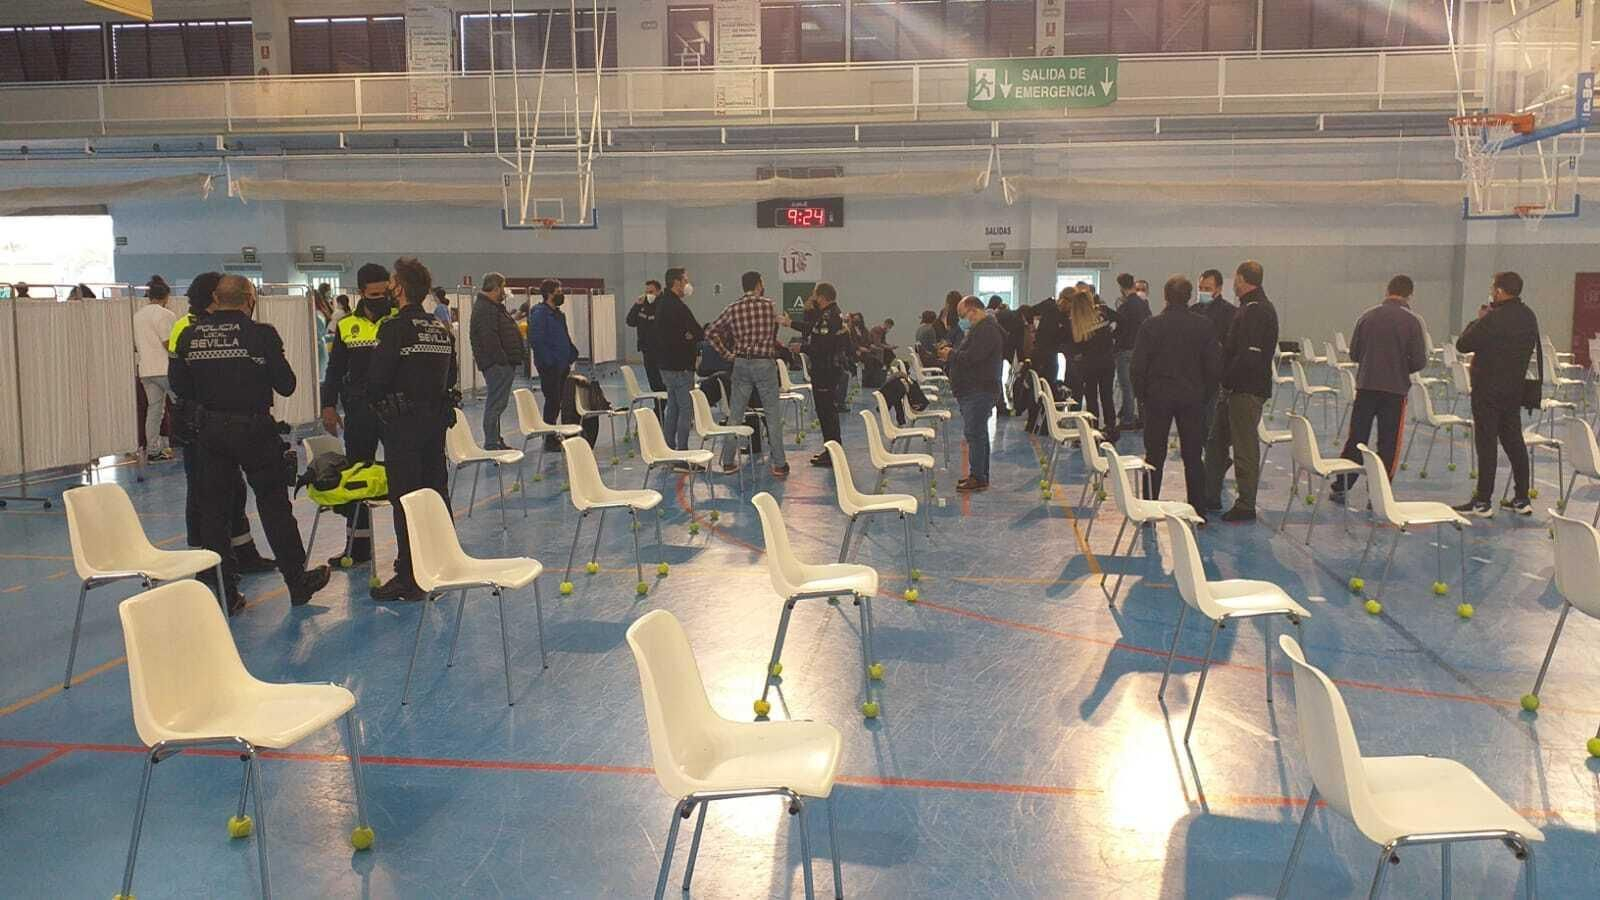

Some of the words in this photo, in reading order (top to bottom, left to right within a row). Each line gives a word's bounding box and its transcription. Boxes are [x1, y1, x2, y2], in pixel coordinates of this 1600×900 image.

[1022, 68, 1066, 81] SALIDA
[1070, 67, 1086, 79] DE
[1015, 85, 1096, 98] EMERGENCIA
[787, 208, 824, 225] 9:24
[984, 226, 1012, 235] SALIDAS
[1065, 224, 1093, 234] SALIDAS
[194, 323, 241, 333] POLICIA
[189, 337, 240, 349] SEVILLA
